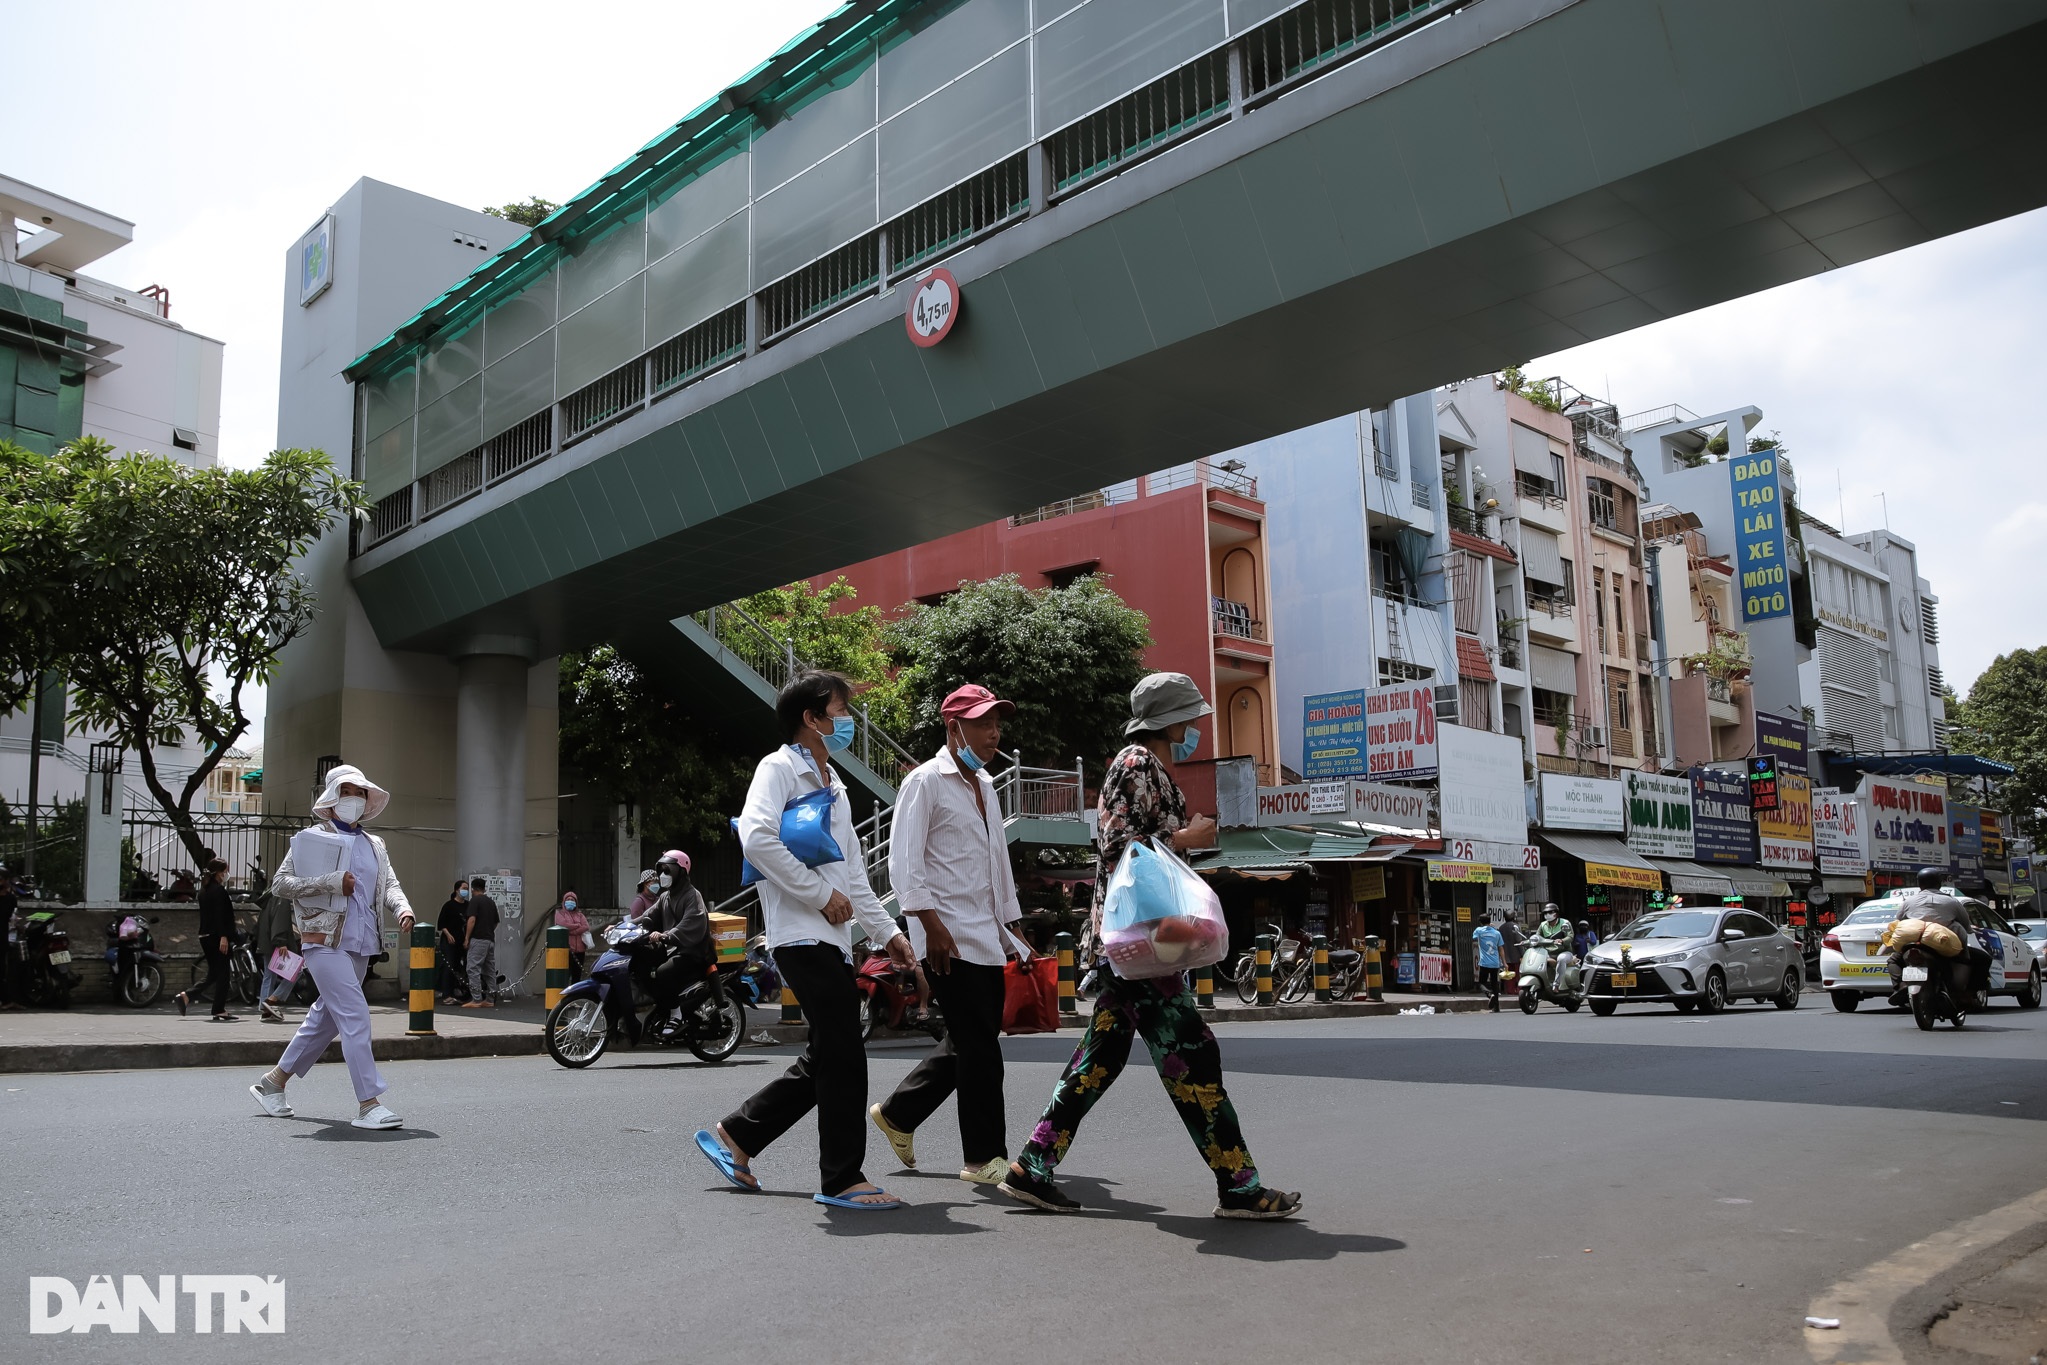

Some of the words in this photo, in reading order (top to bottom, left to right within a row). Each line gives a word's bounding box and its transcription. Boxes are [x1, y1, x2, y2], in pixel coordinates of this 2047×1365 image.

[917, 296, 949, 330] 4,75m
[1734, 459, 1772, 481] ĐÀO
[1738, 486, 1774, 508] TẠO
[1744, 512, 1773, 534] LÁI
[1748, 541, 1774, 561] XE
[1743, 564, 1784, 589] MÔTÔ
[1747, 592, 1785, 615] ÔTÔ
[1308, 709, 1324, 722] GIA
[1328, 702, 1361, 719] HOÀNG
[1367, 690, 1388, 714] KHÁM
[1390, 687, 1410, 715] BỆNH
[1413, 687, 1435, 745] 26
[1368, 724, 1386, 746] UNG
[1388, 716, 1412, 743] BƯỚU
[1369, 747, 1394, 772] SIÊU
[1398, 745, 1414, 769] ÂM
[1565, 789, 1581, 804] MỘC
[1582, 793, 1603, 803] THANH
[1649, 778, 1660, 793] THUỐC
[1704, 777, 1720, 792] NHÀ
[1720, 778, 1744, 795] THUỐC
[1752, 780, 1776, 794] TÂM
[1823, 788, 1837, 796] THUỐC
[1355, 788, 1423, 817] PHOTOCOPY
[1695, 795, 1723, 819] TÂM
[1724, 803, 1751, 822] ANH
[1754, 794, 1777, 808] ANH
[1872, 784, 1898, 812] DỤNG
[1899, 788, 1911, 815] CỤ
[1912, 791, 1919, 812] Y
[1630, 798, 1658, 828] MAI
[1661, 801, 1691, 831] ANH
[1789, 801, 1808, 831] ĐẠT
[1824, 803, 1839, 821] 8A
[1843, 801, 1857, 836] 8A
[1455, 841, 1473, 860] 26
[1523, 847, 1539, 868] 26
[1764, 845, 1781, 863] DỤNG
[1782, 846, 1791, 864] CỤ
[1797, 848, 1814, 862] KHOA
[1596, 866, 1611, 878] PHÒNG
[1619, 868, 1631, 881] MỘC
[1632, 872, 1651, 882] THANH
